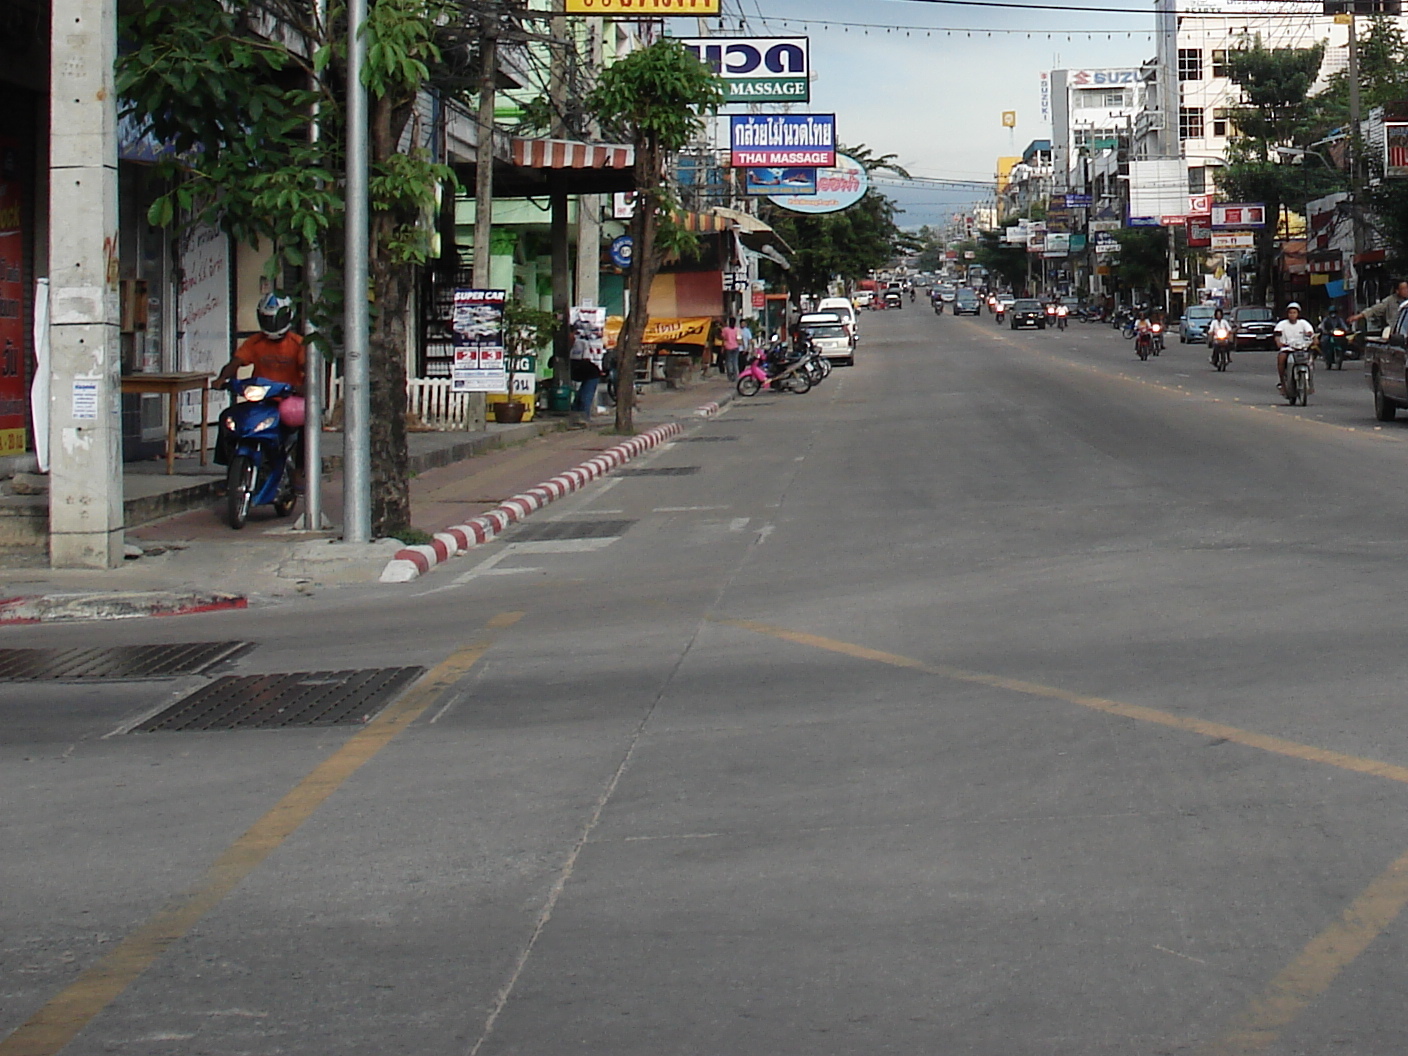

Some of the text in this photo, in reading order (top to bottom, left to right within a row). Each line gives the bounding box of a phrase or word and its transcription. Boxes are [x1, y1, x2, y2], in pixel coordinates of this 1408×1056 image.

[730, 82, 805, 95] MASSAGE
[738, 153, 828, 164] THAI MASSAGE
[454, 291, 506, 301] SUPER CAR
